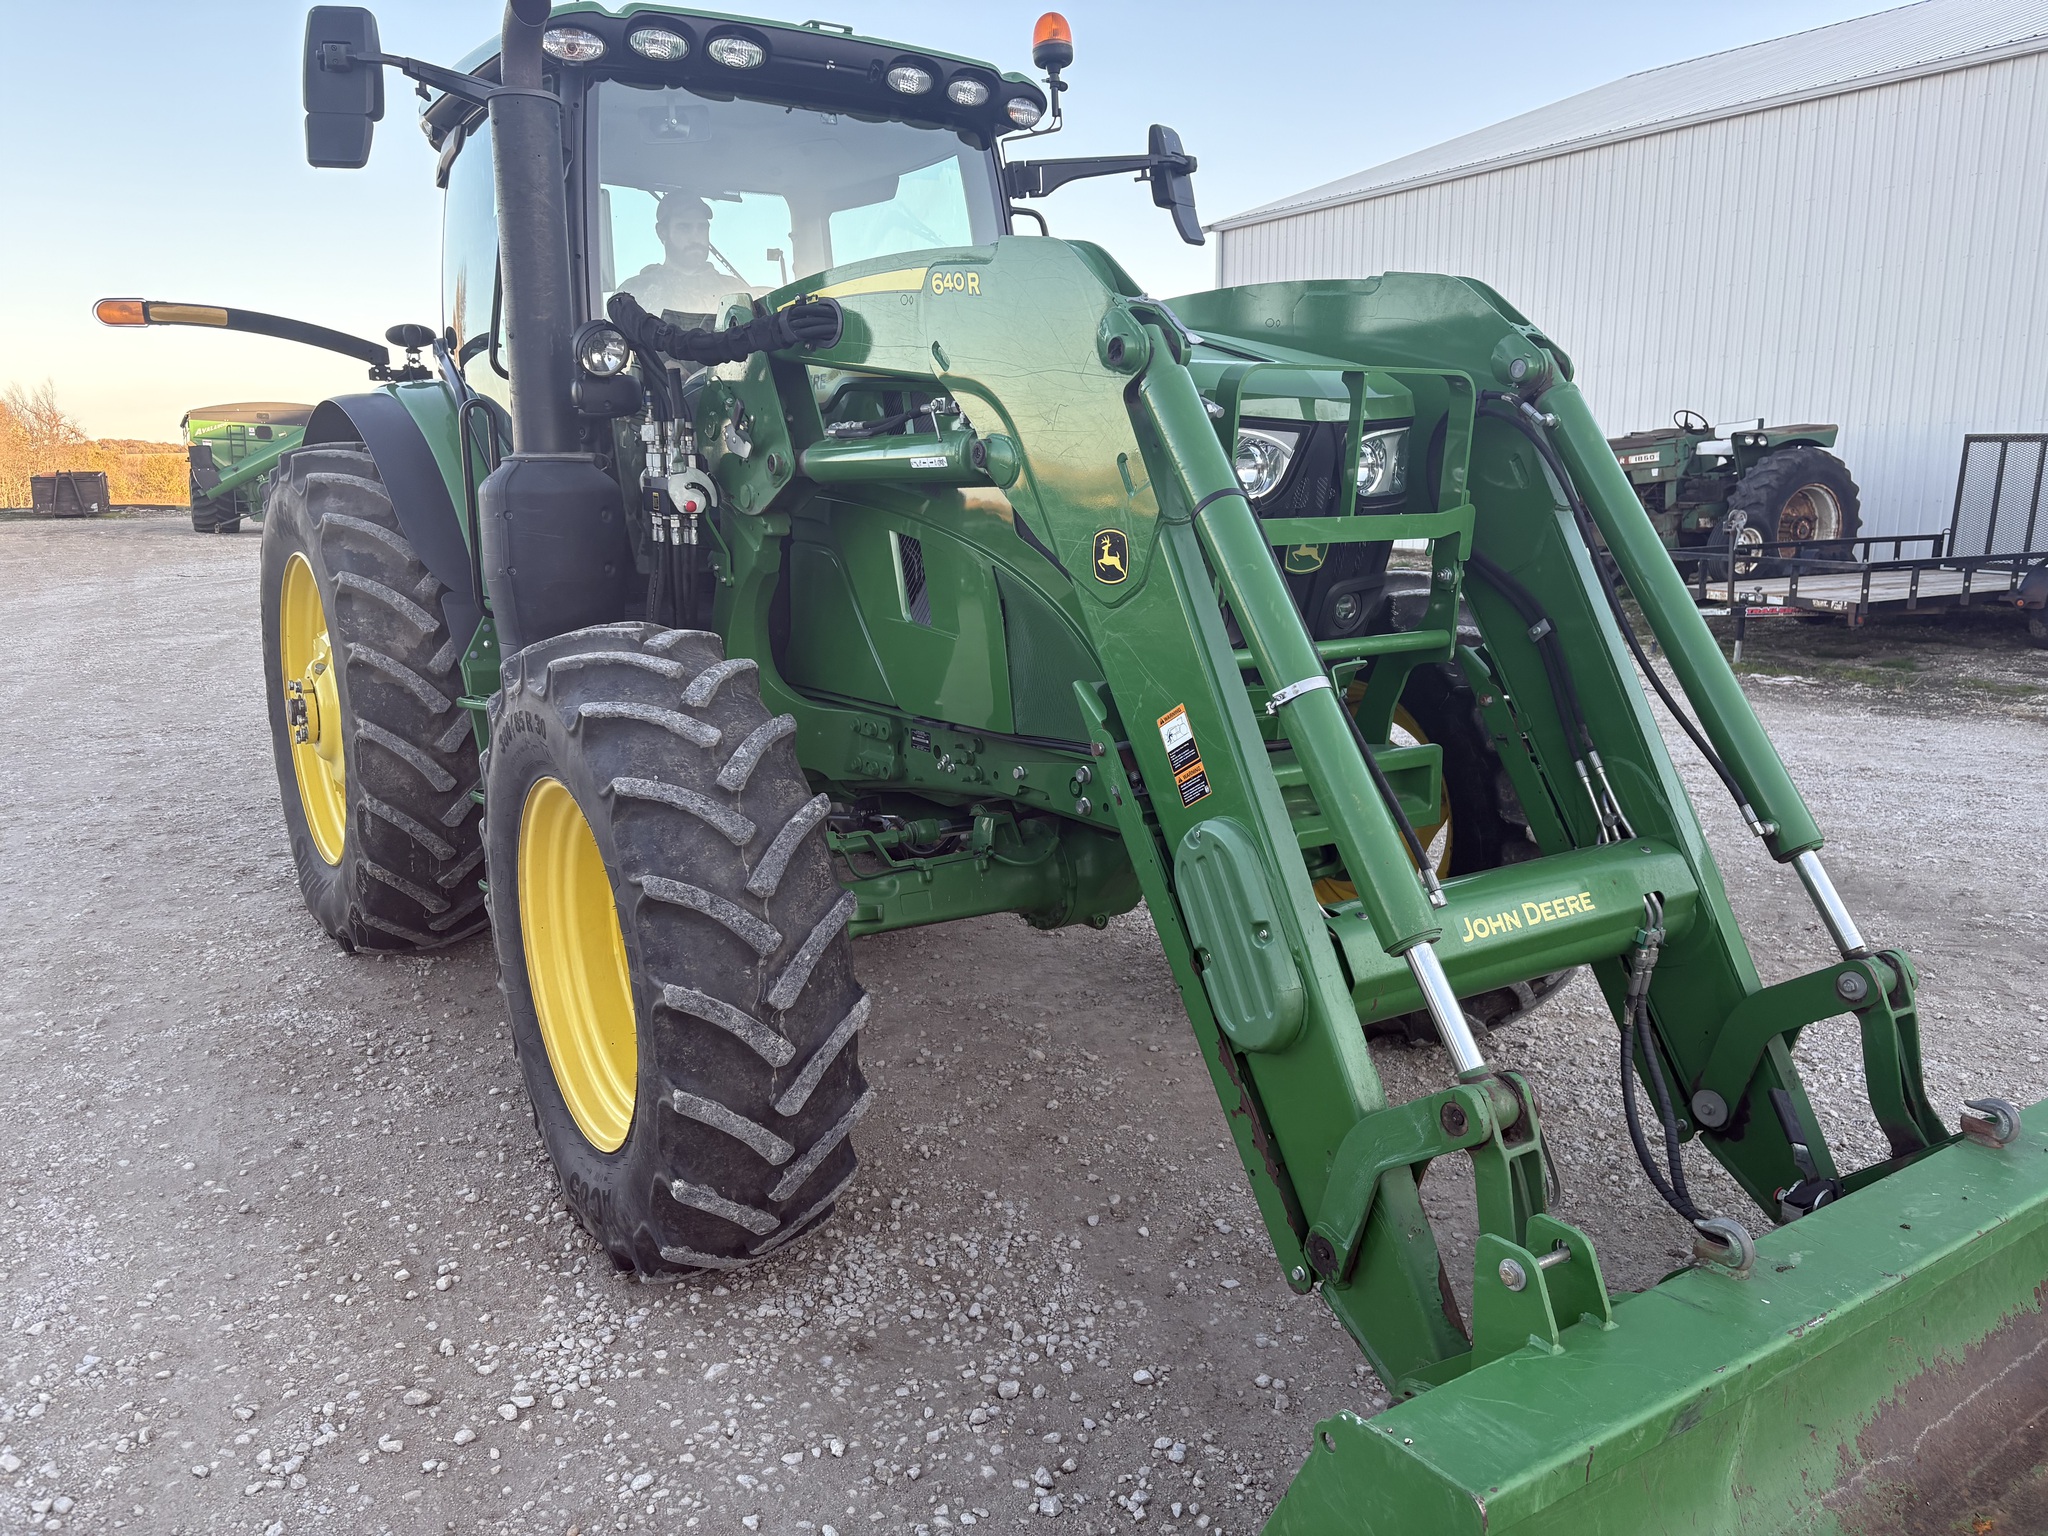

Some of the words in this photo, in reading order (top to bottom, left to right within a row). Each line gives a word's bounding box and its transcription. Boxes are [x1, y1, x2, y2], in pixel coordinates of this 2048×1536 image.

[931, 272, 983, 295] 640R
[1164, 707, 1182, 721] WARNING
[1182, 765, 1202, 780] WARNING
[1462, 909, 1523, 943] JOHN
[1521, 891, 1596, 926] DEERE
